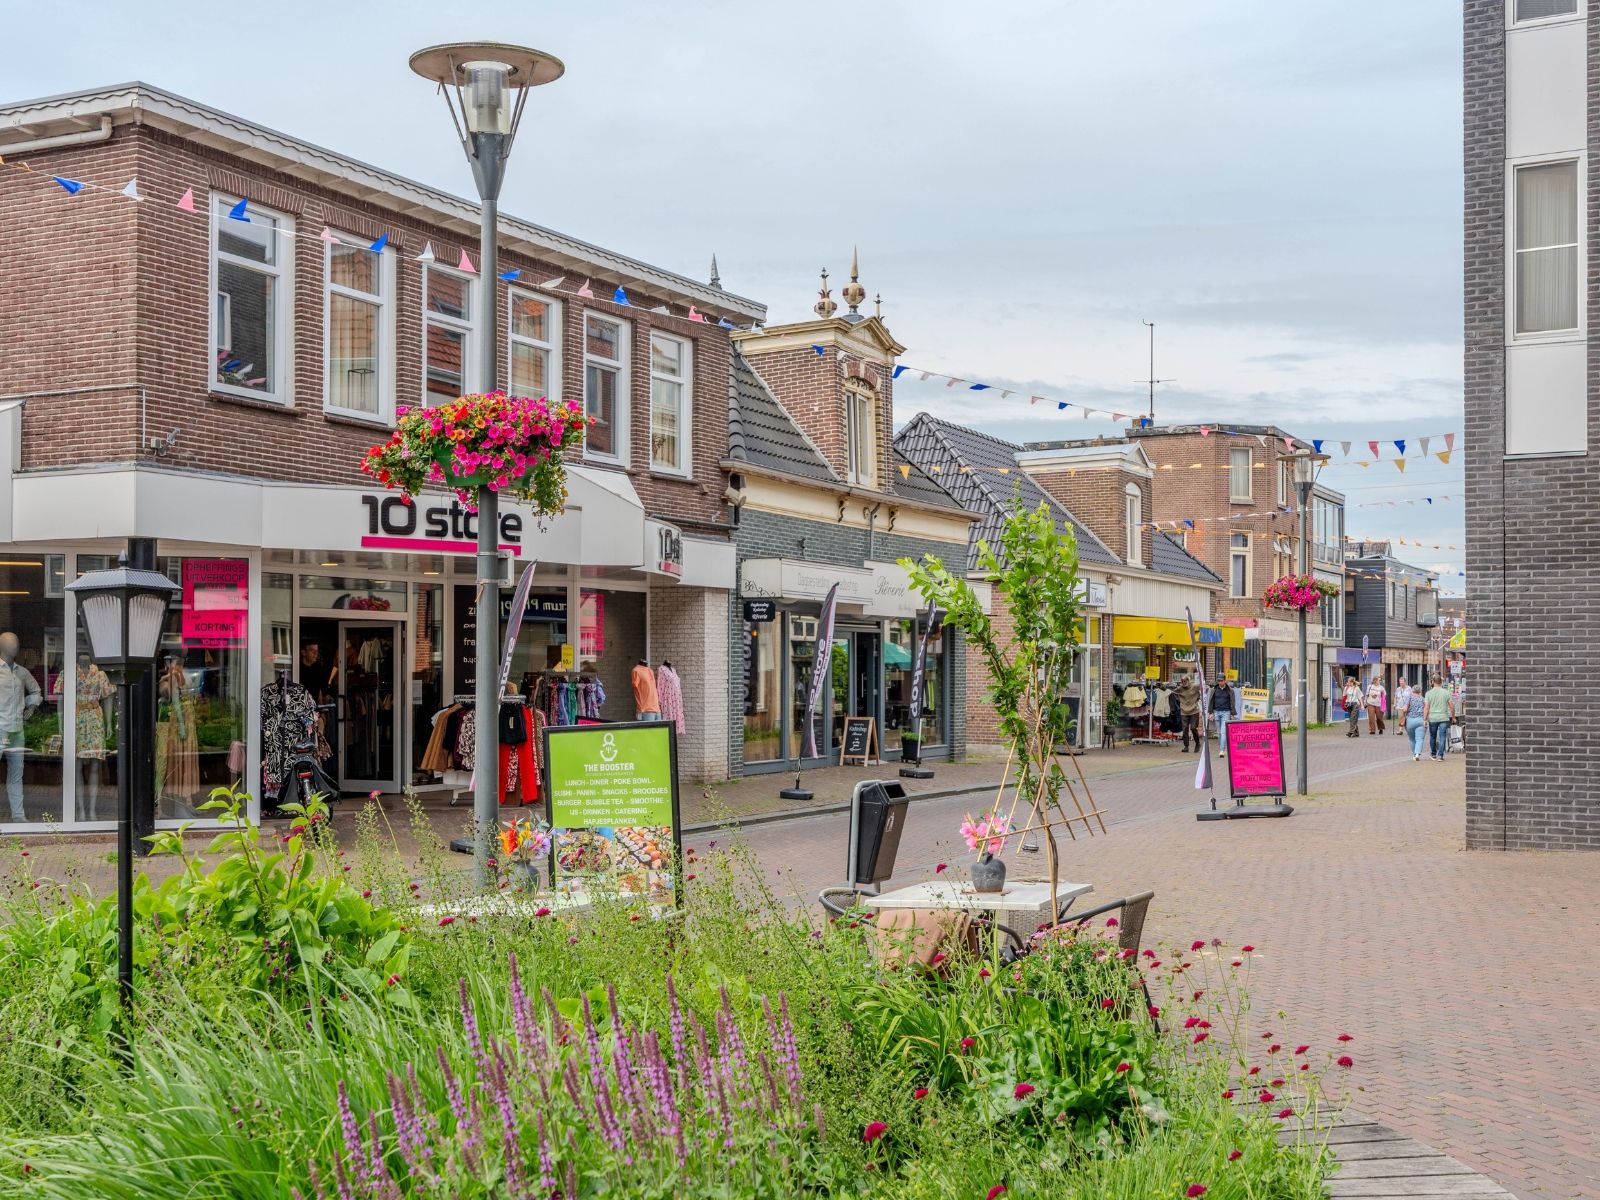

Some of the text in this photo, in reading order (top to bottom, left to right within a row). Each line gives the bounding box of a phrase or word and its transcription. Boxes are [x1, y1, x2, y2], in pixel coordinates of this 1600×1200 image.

[362, 495, 523, 543] 10 stoe
[195, 623, 235, 632] KORTING
[813, 638, 826, 686] store
[1230, 733, 1276, 742] UITVERKOOP
[584, 762, 635, 772] THE BOOSTER
[614, 807, 648, 815] CATERING
[583, 817, 637, 825] HAPJESPLANKEN
